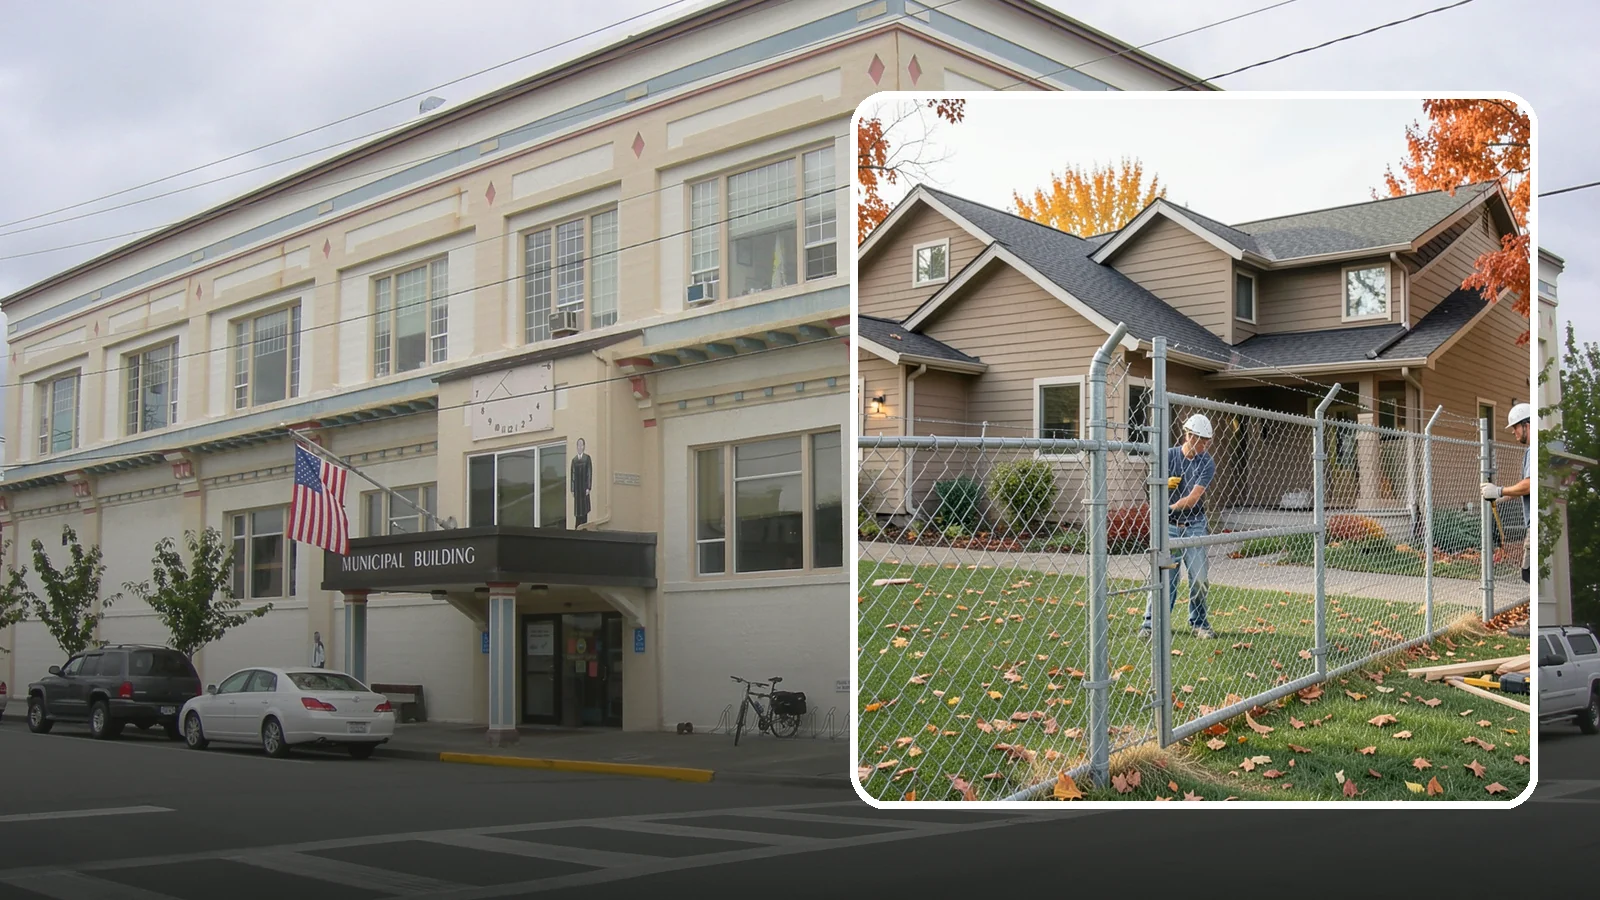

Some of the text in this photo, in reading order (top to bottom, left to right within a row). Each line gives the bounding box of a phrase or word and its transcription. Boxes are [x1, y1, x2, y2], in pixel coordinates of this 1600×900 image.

[536, 402, 540, 410] 4
[481, 407, 485, 415] 8
[488, 417, 492, 425] 9
[529, 414, 533, 422] 3
[521, 420, 525, 428] 2
[508, 425, 513, 433] 12
[342, 546, 475, 572] MUNICIPAL BUILDING
